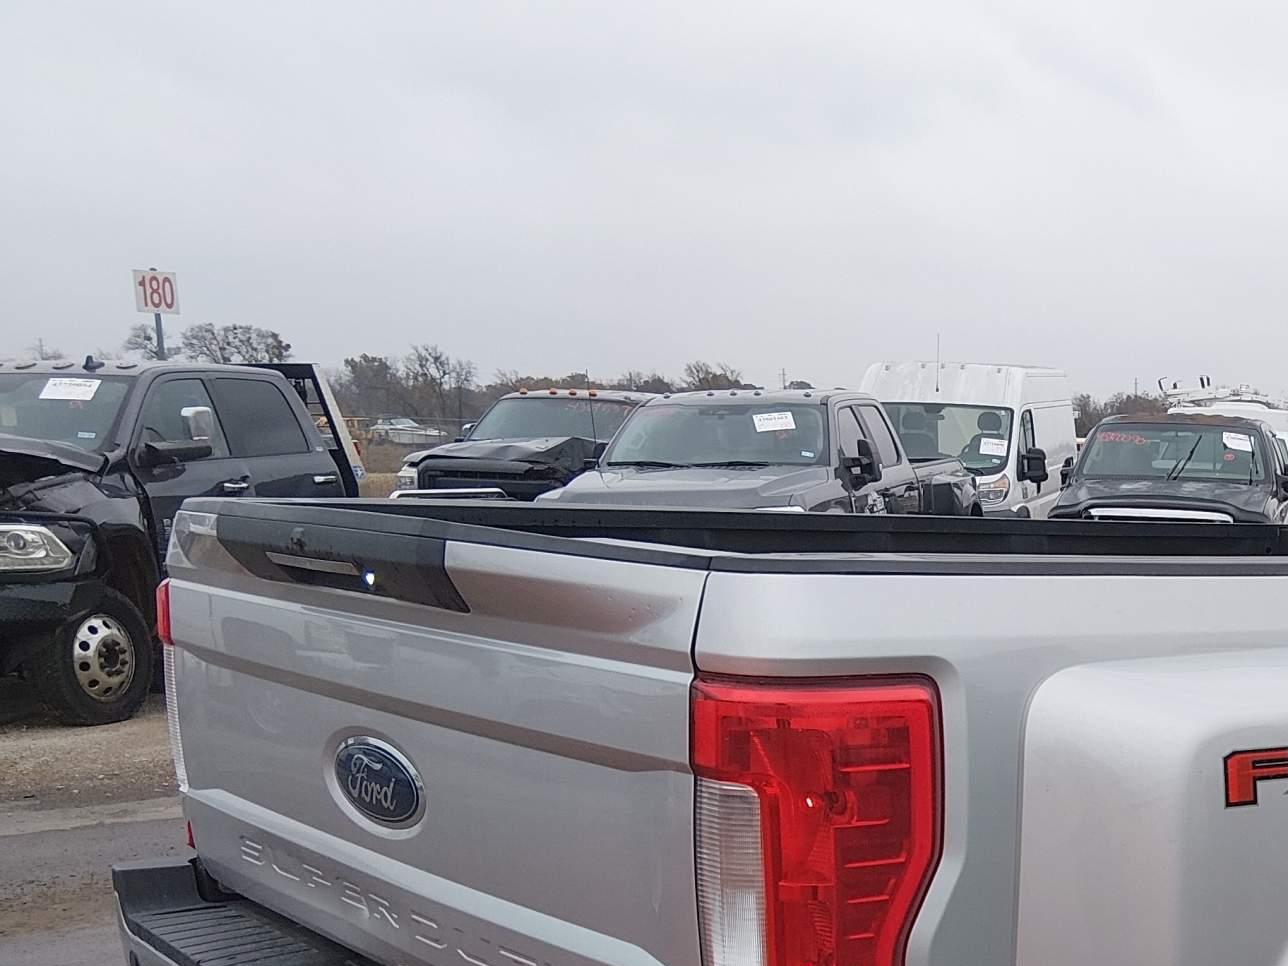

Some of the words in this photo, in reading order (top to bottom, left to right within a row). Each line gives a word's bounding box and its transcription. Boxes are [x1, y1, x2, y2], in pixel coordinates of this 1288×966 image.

[138, 275, 174, 309] 180
[347, 753, 398, 811] Ford
[239, 834, 401, 930] SUPER
